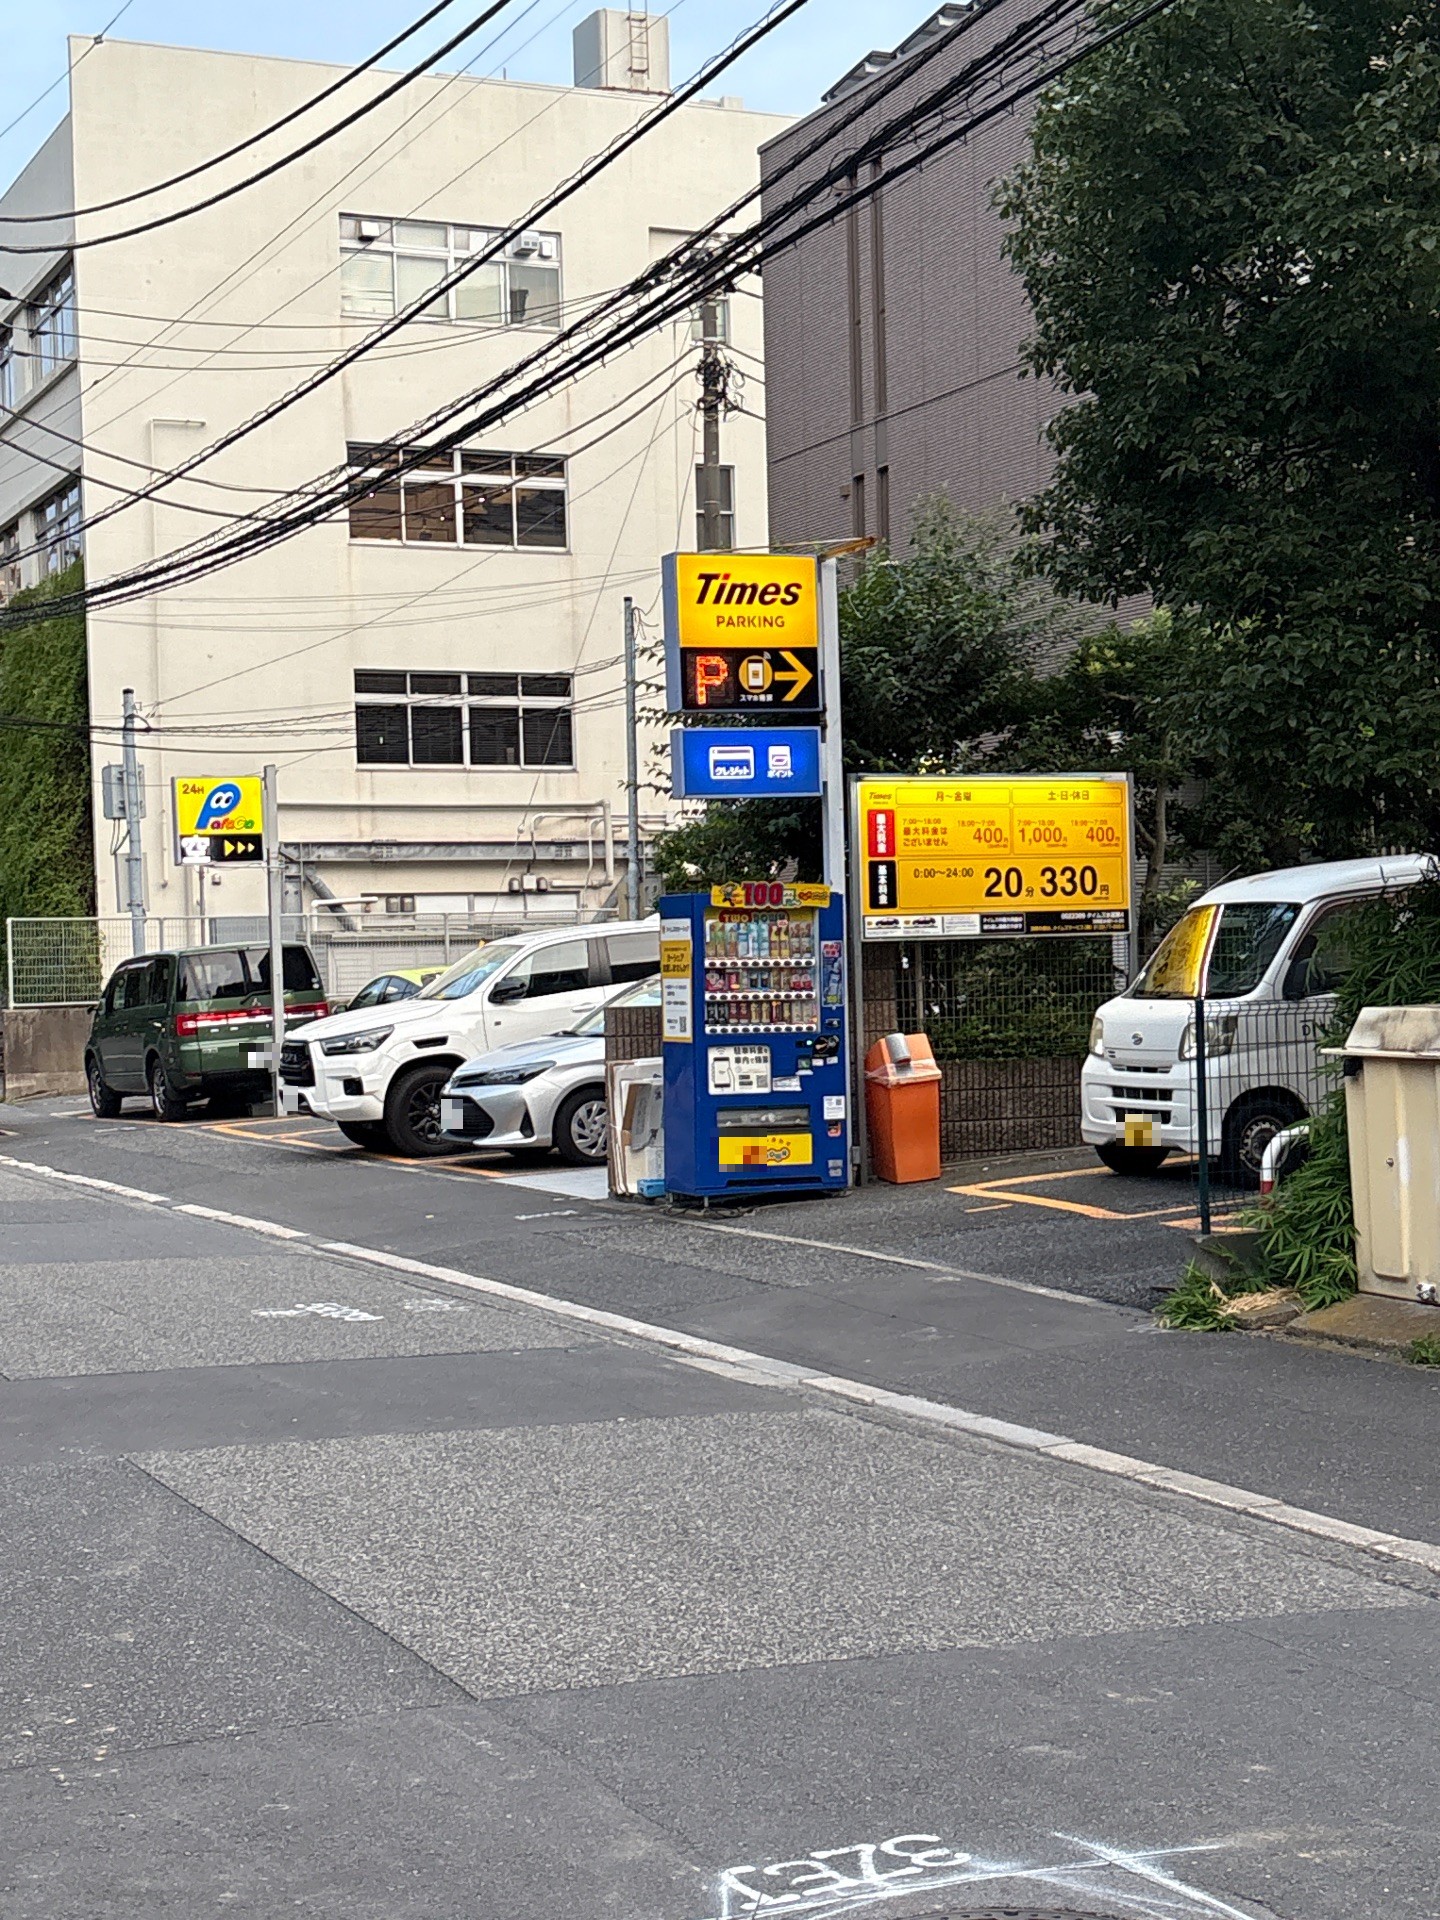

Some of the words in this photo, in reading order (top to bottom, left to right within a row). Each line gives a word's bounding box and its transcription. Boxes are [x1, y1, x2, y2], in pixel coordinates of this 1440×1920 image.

[696, 573, 803, 606] Times
[716, 615, 785, 628] PARKING
[696, 655, 728, 705] P
[715, 766, 749, 776] クレジット
[767, 769, 794, 778] ポイント
[182, 783, 204, 794] 24H
[868, 791, 892, 801] Times
[903, 838, 948, 847] ございません
[742, 882, 784, 906] 100
